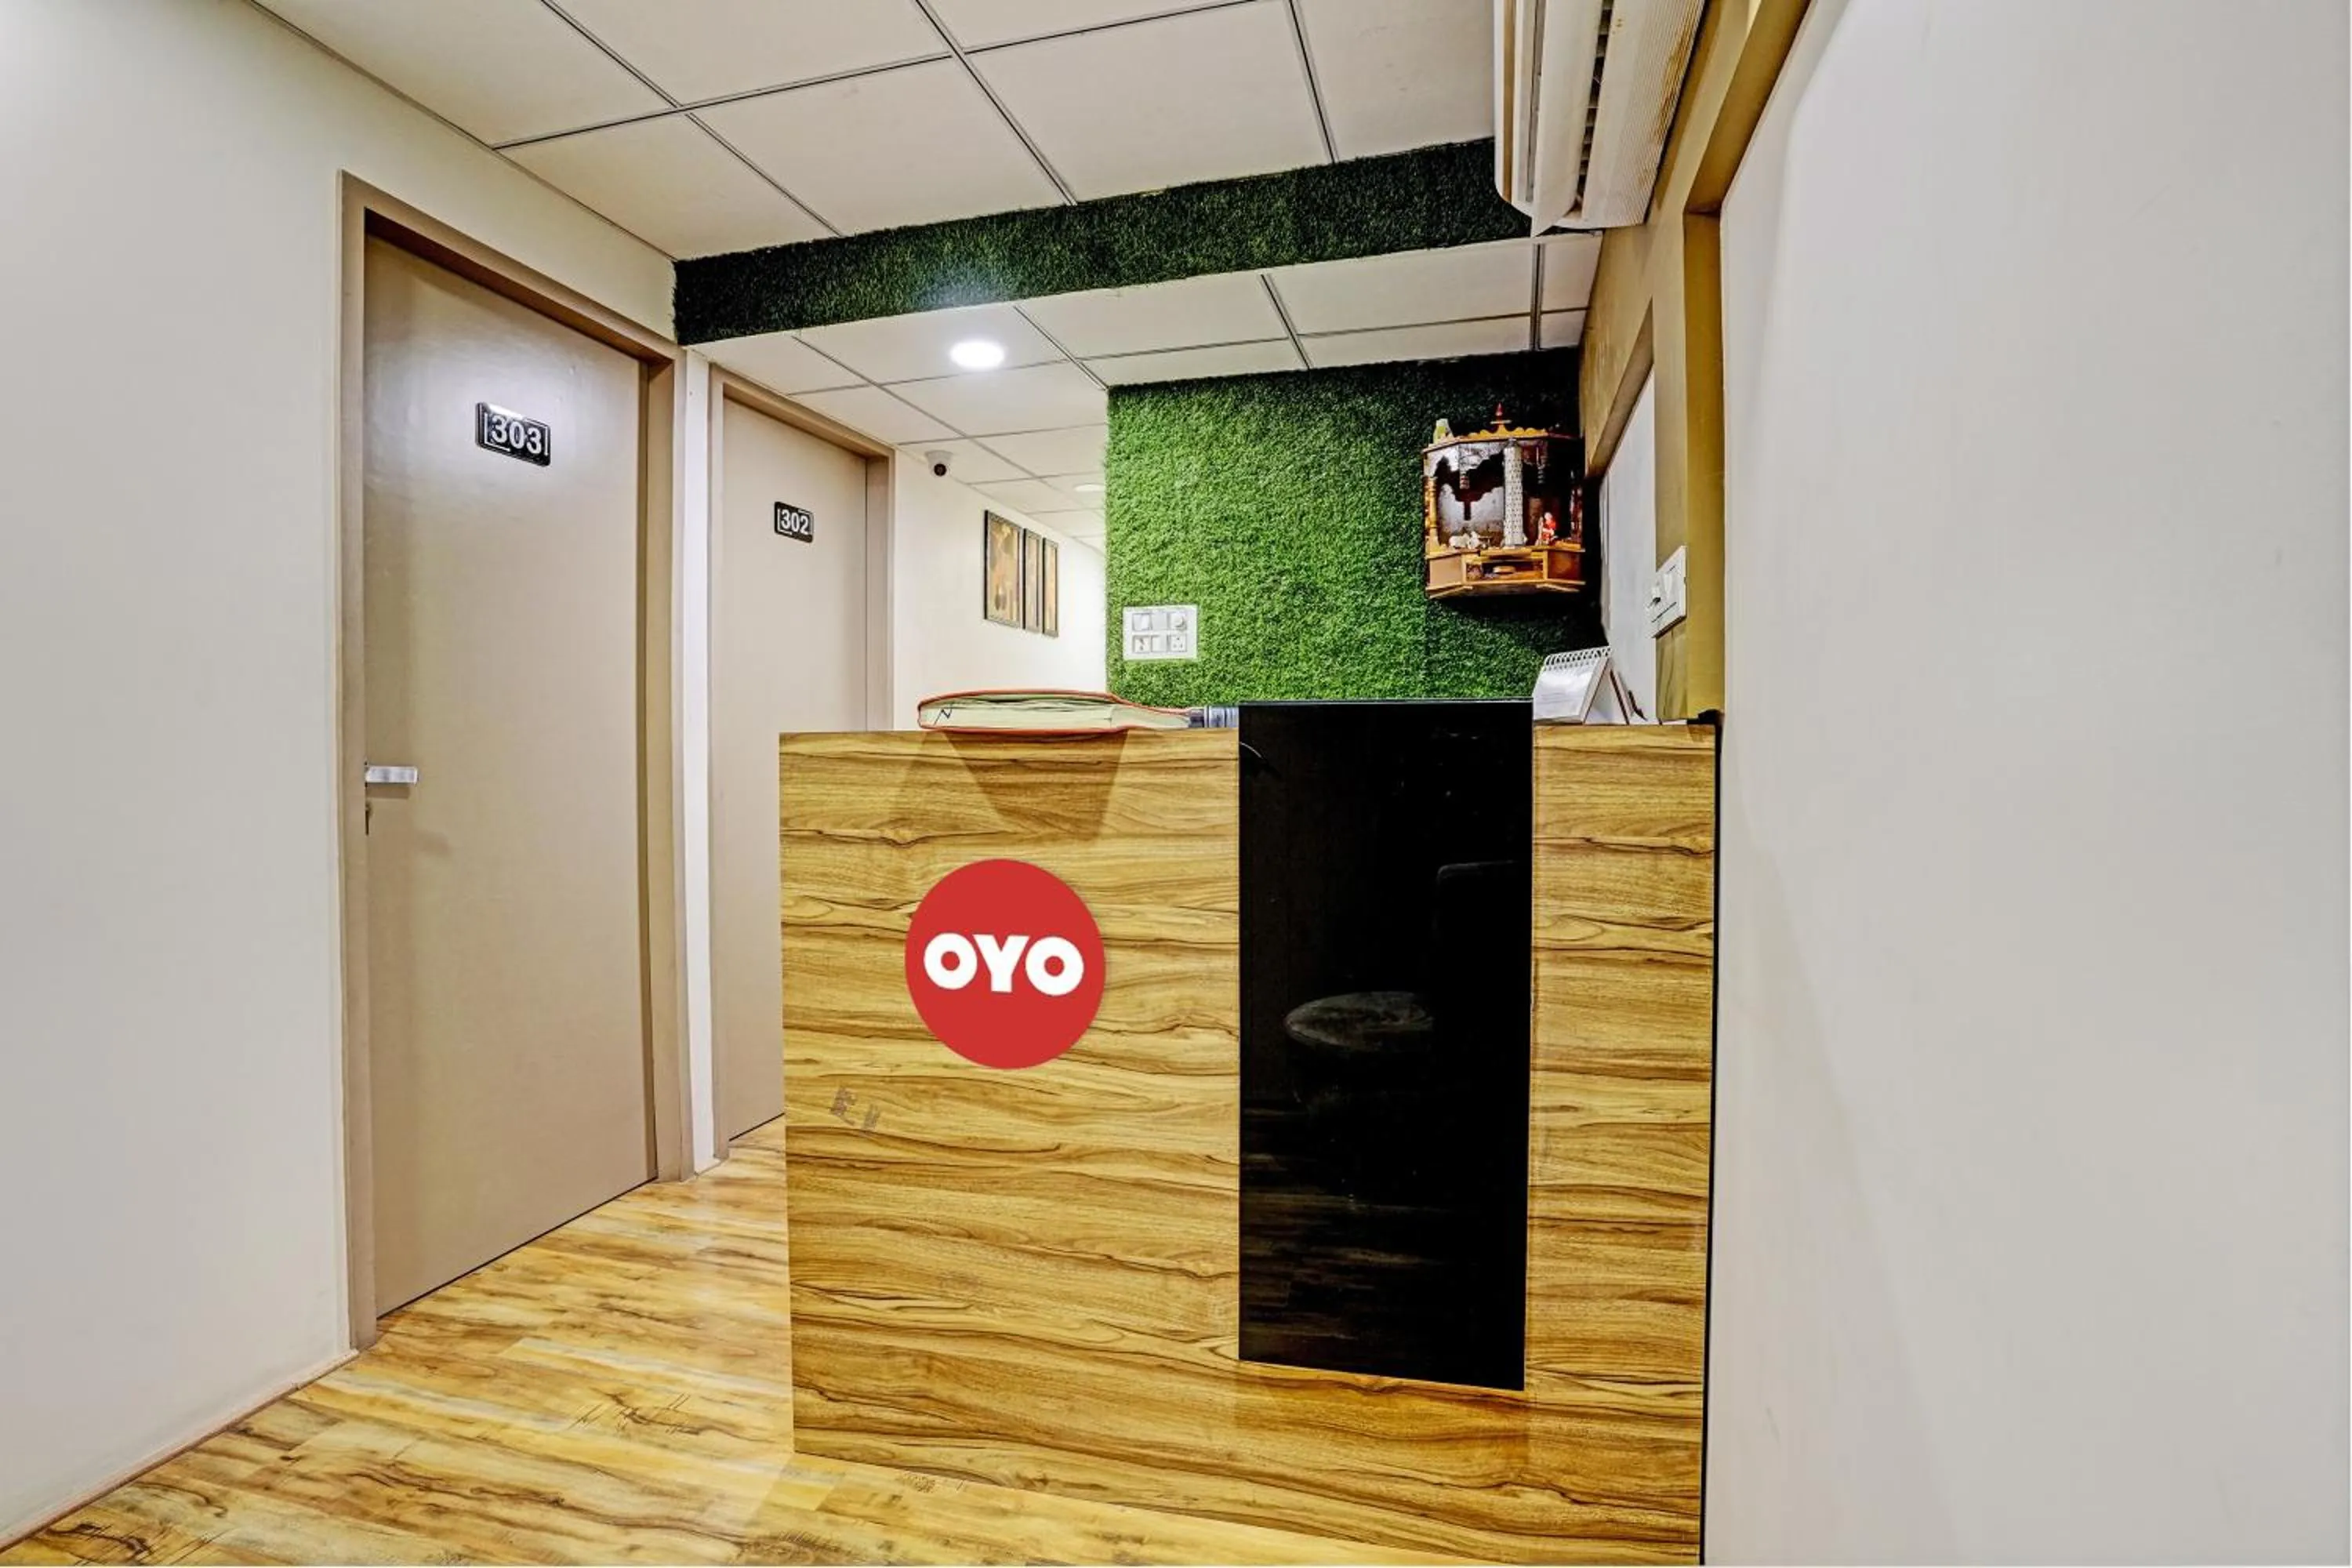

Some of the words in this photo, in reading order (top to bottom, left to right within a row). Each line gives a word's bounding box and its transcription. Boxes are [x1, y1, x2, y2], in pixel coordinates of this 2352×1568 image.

[492, 414, 542, 455] 303
[781, 509, 808, 535] 302
[924, 932, 1084, 996] OYO
